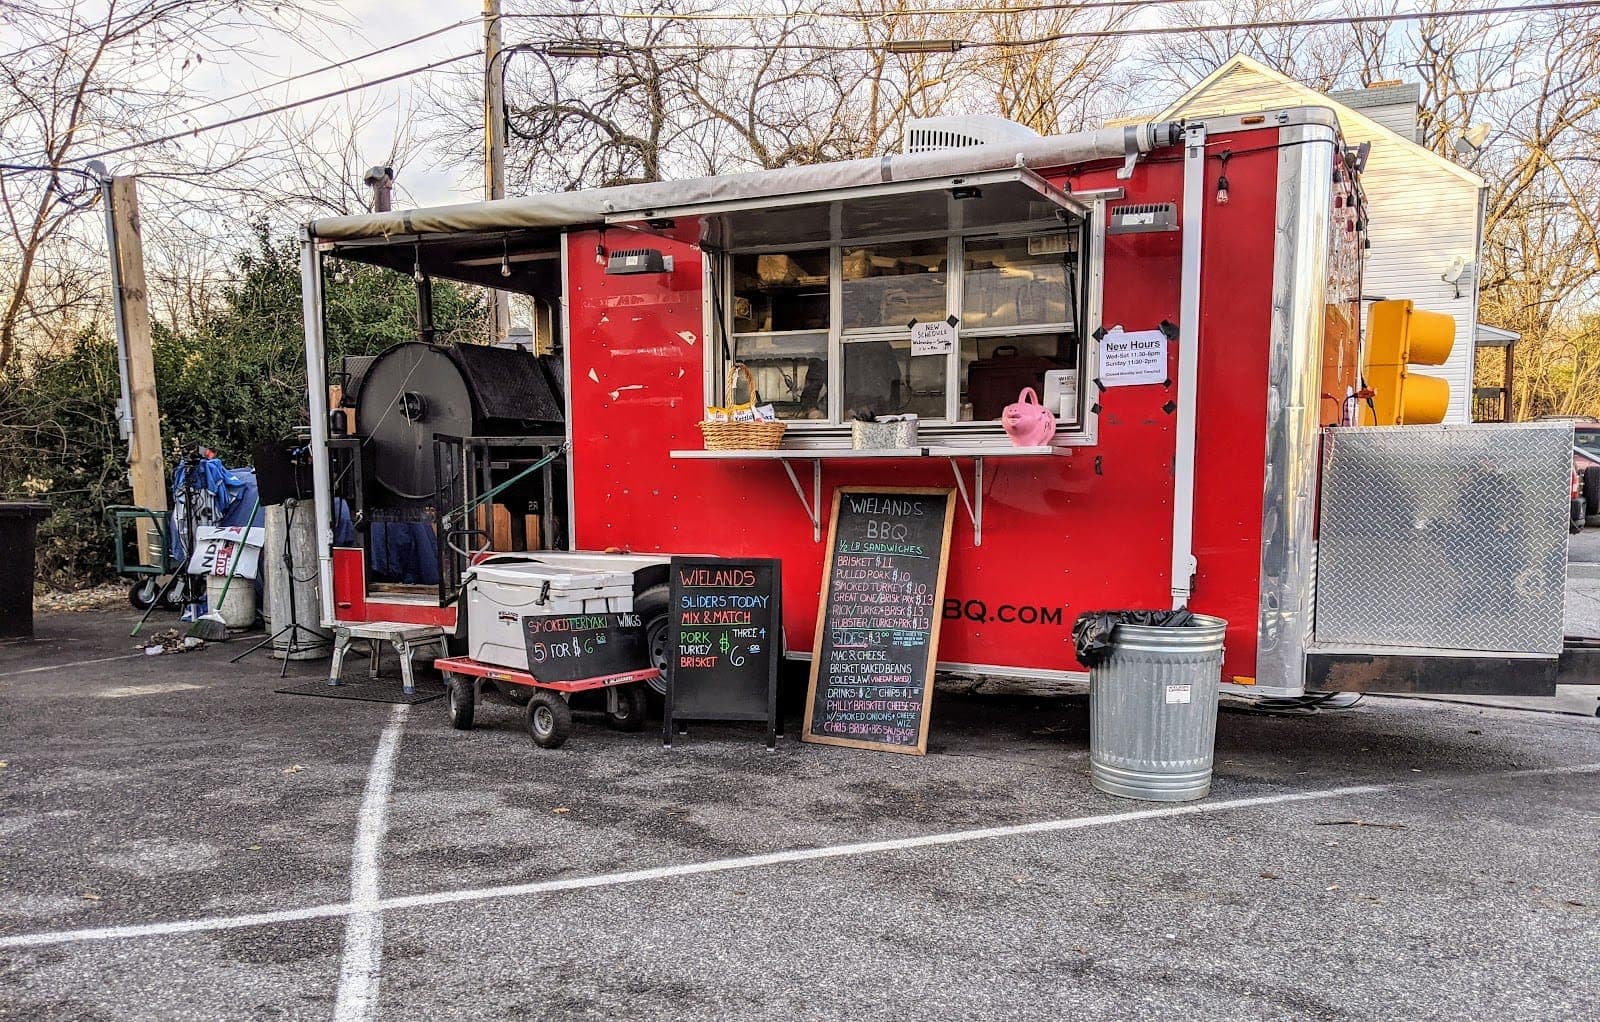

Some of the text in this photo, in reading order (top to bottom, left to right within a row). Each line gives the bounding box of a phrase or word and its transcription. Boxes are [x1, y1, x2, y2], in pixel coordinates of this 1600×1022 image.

[918, 330, 948, 338] SCHEDULE
[1106, 341, 1160, 351] New Hours
[850, 499, 924, 516] WIELANDS
[867, 520, 908, 542] BBQ
[851, 542, 860, 551] LB
[863, 543, 923, 555] SANDWICHES
[838, 556, 894, 568] BRISKET $11
[680, 568, 756, 586] WIELANDS
[836, 568, 910, 581] PULLED PORK $10
[834, 582, 926, 594] SMOKED TURKEY $10
[681, 594, 769, 608] SLIDERS TODAY
[834, 592, 858, 602] GREAT
[916, 594, 934, 606] $13
[682, 611, 750, 624] MIX & MATCH
[906, 605, 924, 618] $13
[528, 612, 642, 634] SMOKED TERIYAKI WINGS
[912, 618, 928, 630] $13
[680, 627, 766, 644] PORK THREE 4
[550, 643, 571, 658] FOR
[680, 644, 712, 655] TURKEY
[831, 650, 886, 661] MAC & CHEESE
[680, 656, 718, 668] BRISKET
[830, 664, 912, 674] BRISKET BAKED BEANS
[830, 676, 868, 684] COLESLAW
[826, 701, 853, 711] PHILLY
[866, 712, 892, 721] ONIONS
[896, 720, 912, 728] WIZ
[883, 726, 915, 736] SAUSAGE
